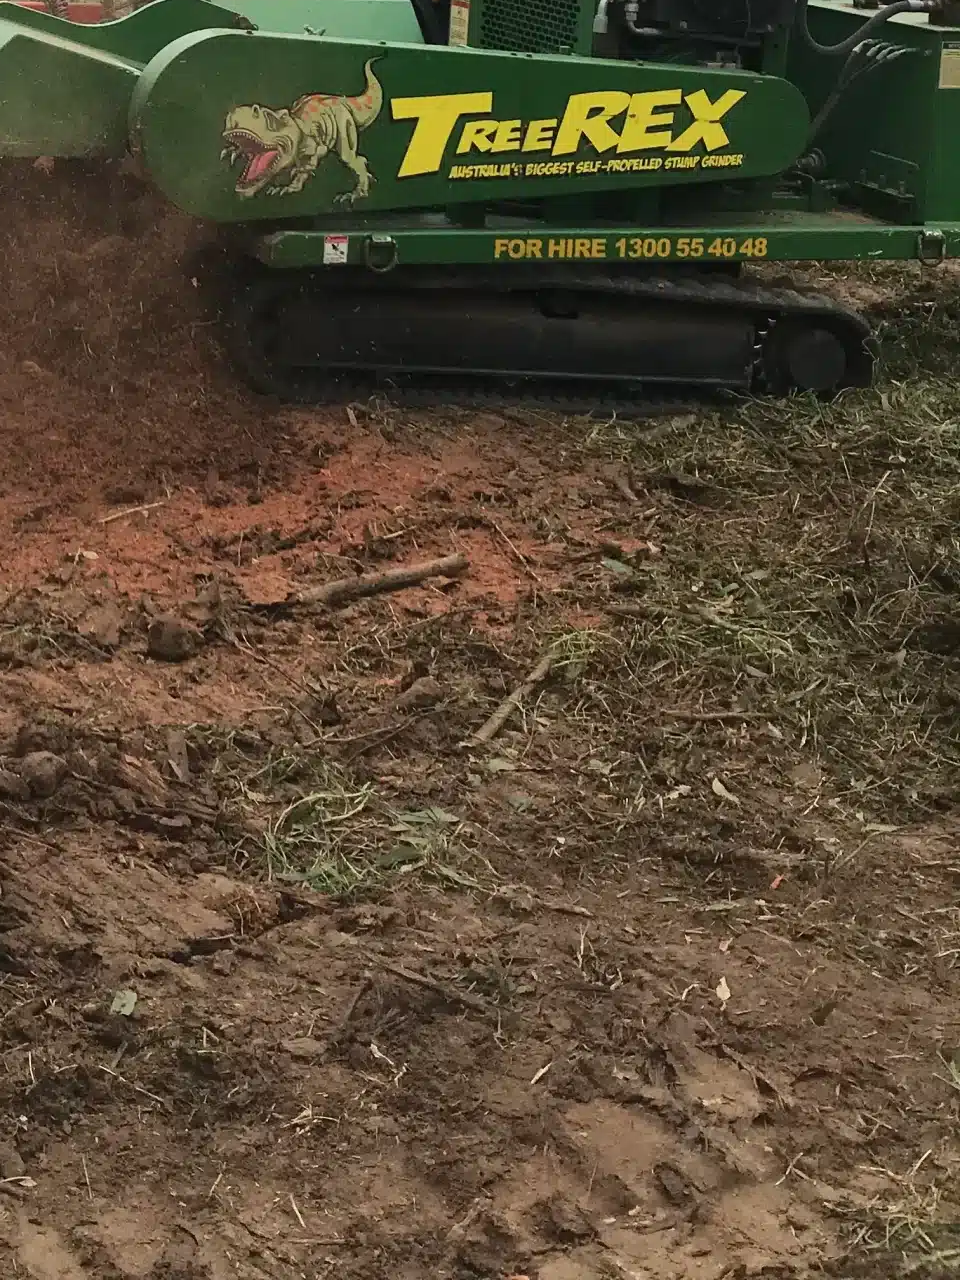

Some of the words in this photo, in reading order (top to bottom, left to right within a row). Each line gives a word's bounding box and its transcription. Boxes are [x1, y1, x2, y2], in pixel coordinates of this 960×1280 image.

[525, 161, 575, 176] BIGGEST
[575, 157, 663, 173] SELF-PROPELLED
[664, 155, 700, 169] STUMP
[701, 153, 745, 168] GRINDER
[494, 238, 543, 258] FOR
[547, 238, 607, 258] HIRE
[614, 237, 670, 258] 1300
[675, 237, 704, 257] 55
[707, 237, 737, 258] 40
[738, 237, 768, 257] 48
